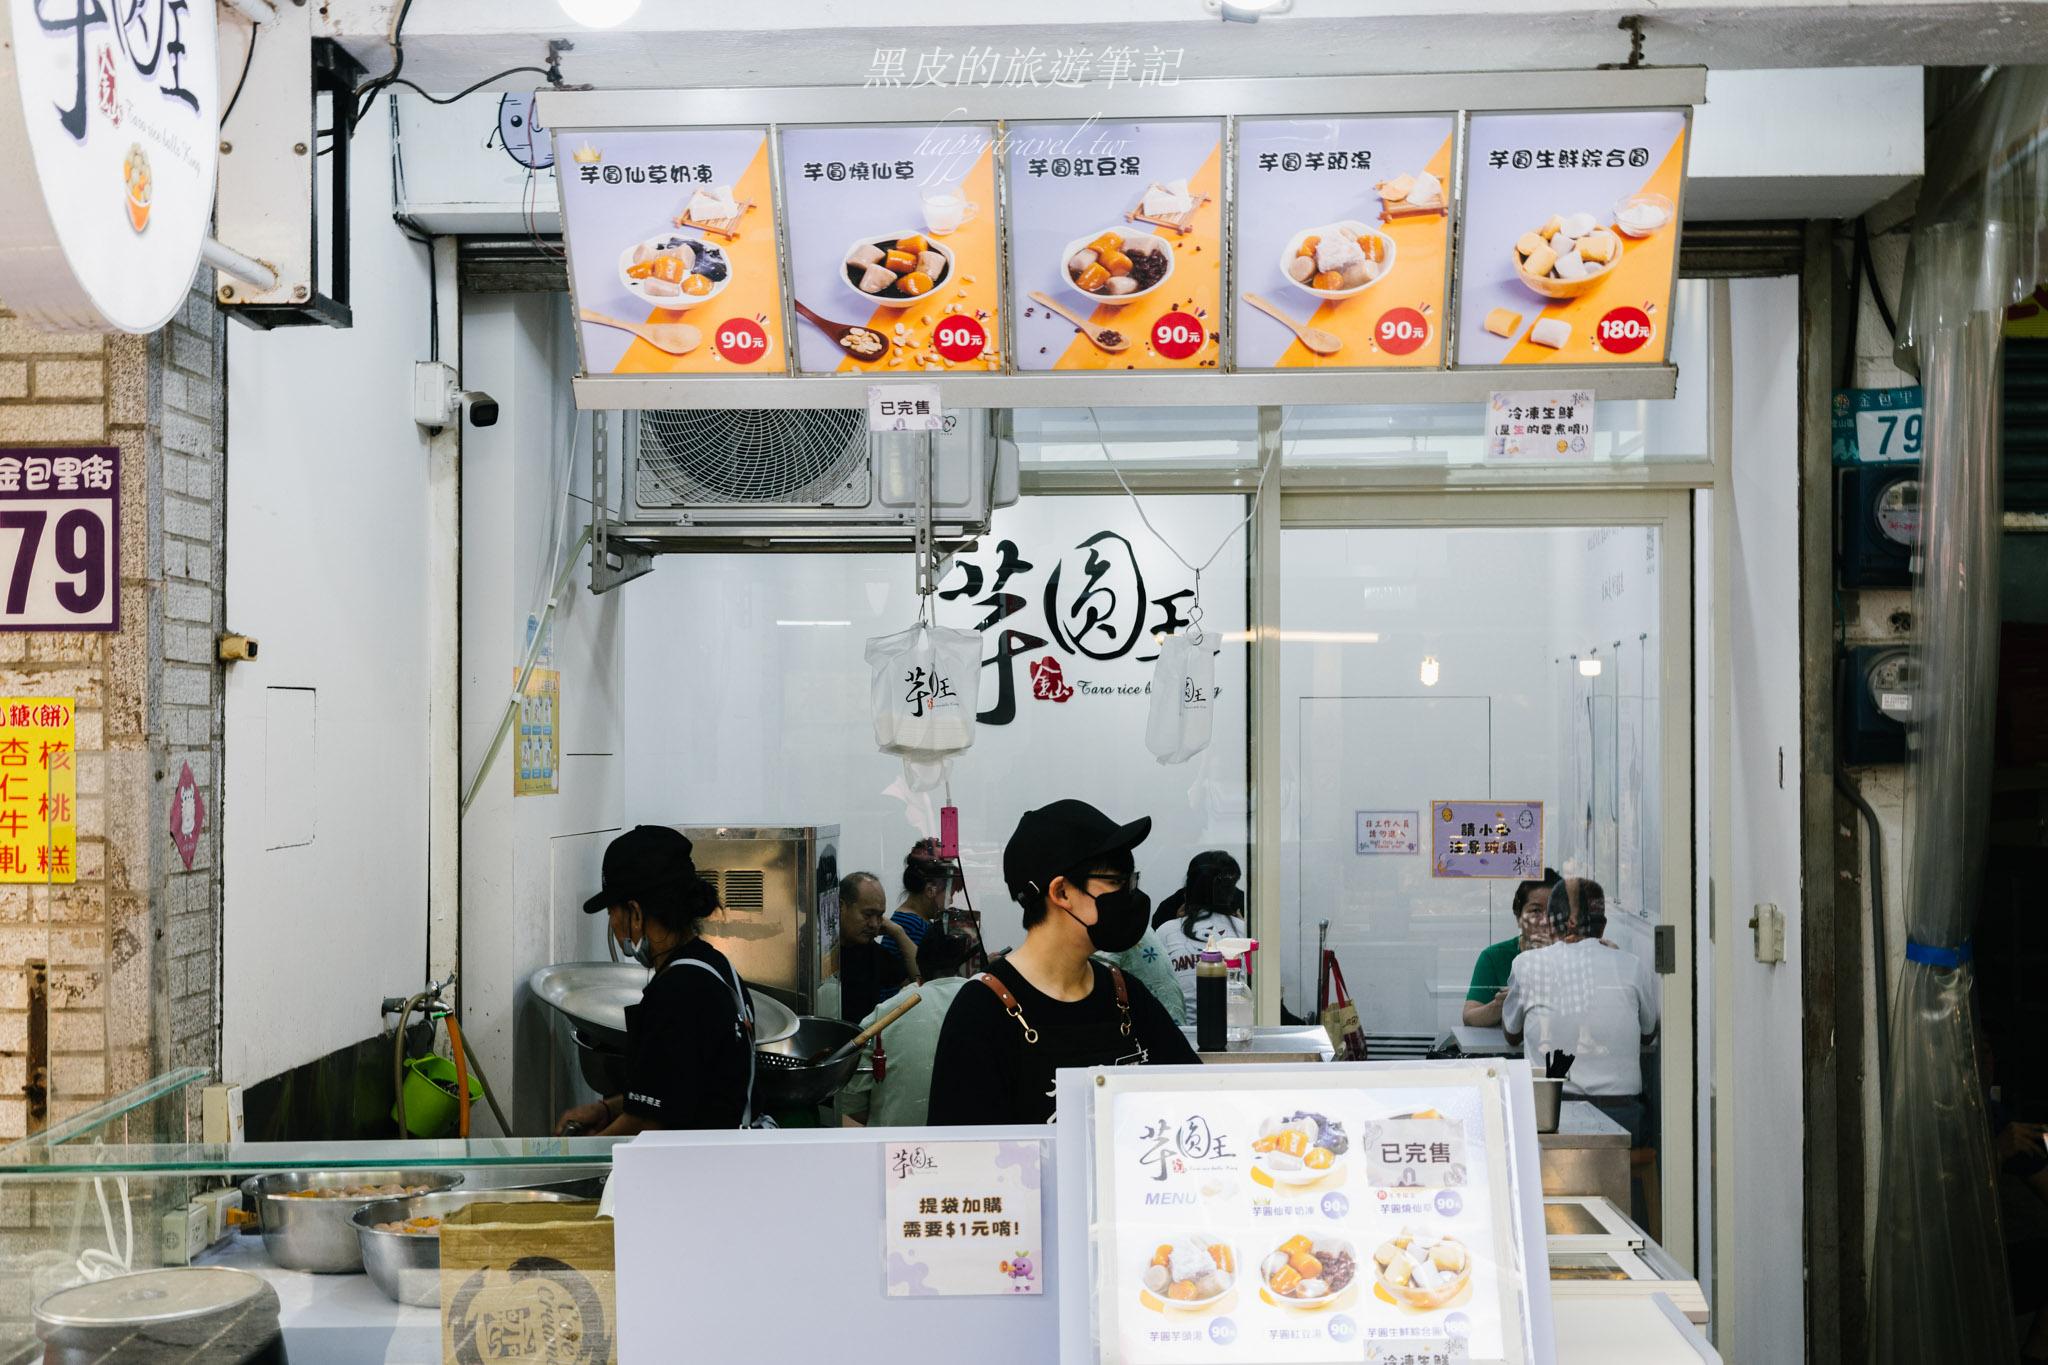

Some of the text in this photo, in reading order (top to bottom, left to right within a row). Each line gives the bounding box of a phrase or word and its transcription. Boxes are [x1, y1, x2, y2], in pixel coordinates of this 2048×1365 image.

[1028, 156, 1141, 178] 芋圓紅豆湯
[1259, 150, 1372, 172] 芋圓芋頭湯
[1489, 147, 1650, 170] 芋圓生鮮綜合圓
[580, 164, 713, 184] 芋圓仙草奶凍
[804, 160, 915, 182] 芋圓燒仙草
[720, 331, 765, 349] 90元
[939, 328, 984, 347] 90元
[1157, 325, 1201, 344] 90元
[1380, 320, 1425, 340] 90元
[1600, 319, 1651, 340] 180元
[880, 400, 931, 416] 已完售
[1508, 406, 1575, 420] 冷凍生鮮
[1877, 414, 1923, 456] 79
[0, 453, 114, 491] 金包里街
[0, 508, 106, 615] 79
[1077, 679, 1114, 695] Taro
[1117, 681, 1142, 695] rice
[0, 704, 70, 728] 糖(餅)
[38, 740, 71, 875] 核桃糕
[1381, 1142, 1450, 1164] 已完售
[919, 1196, 1003, 1215] 提袋加購
[1145, 1192, 1197, 1206] MENU
